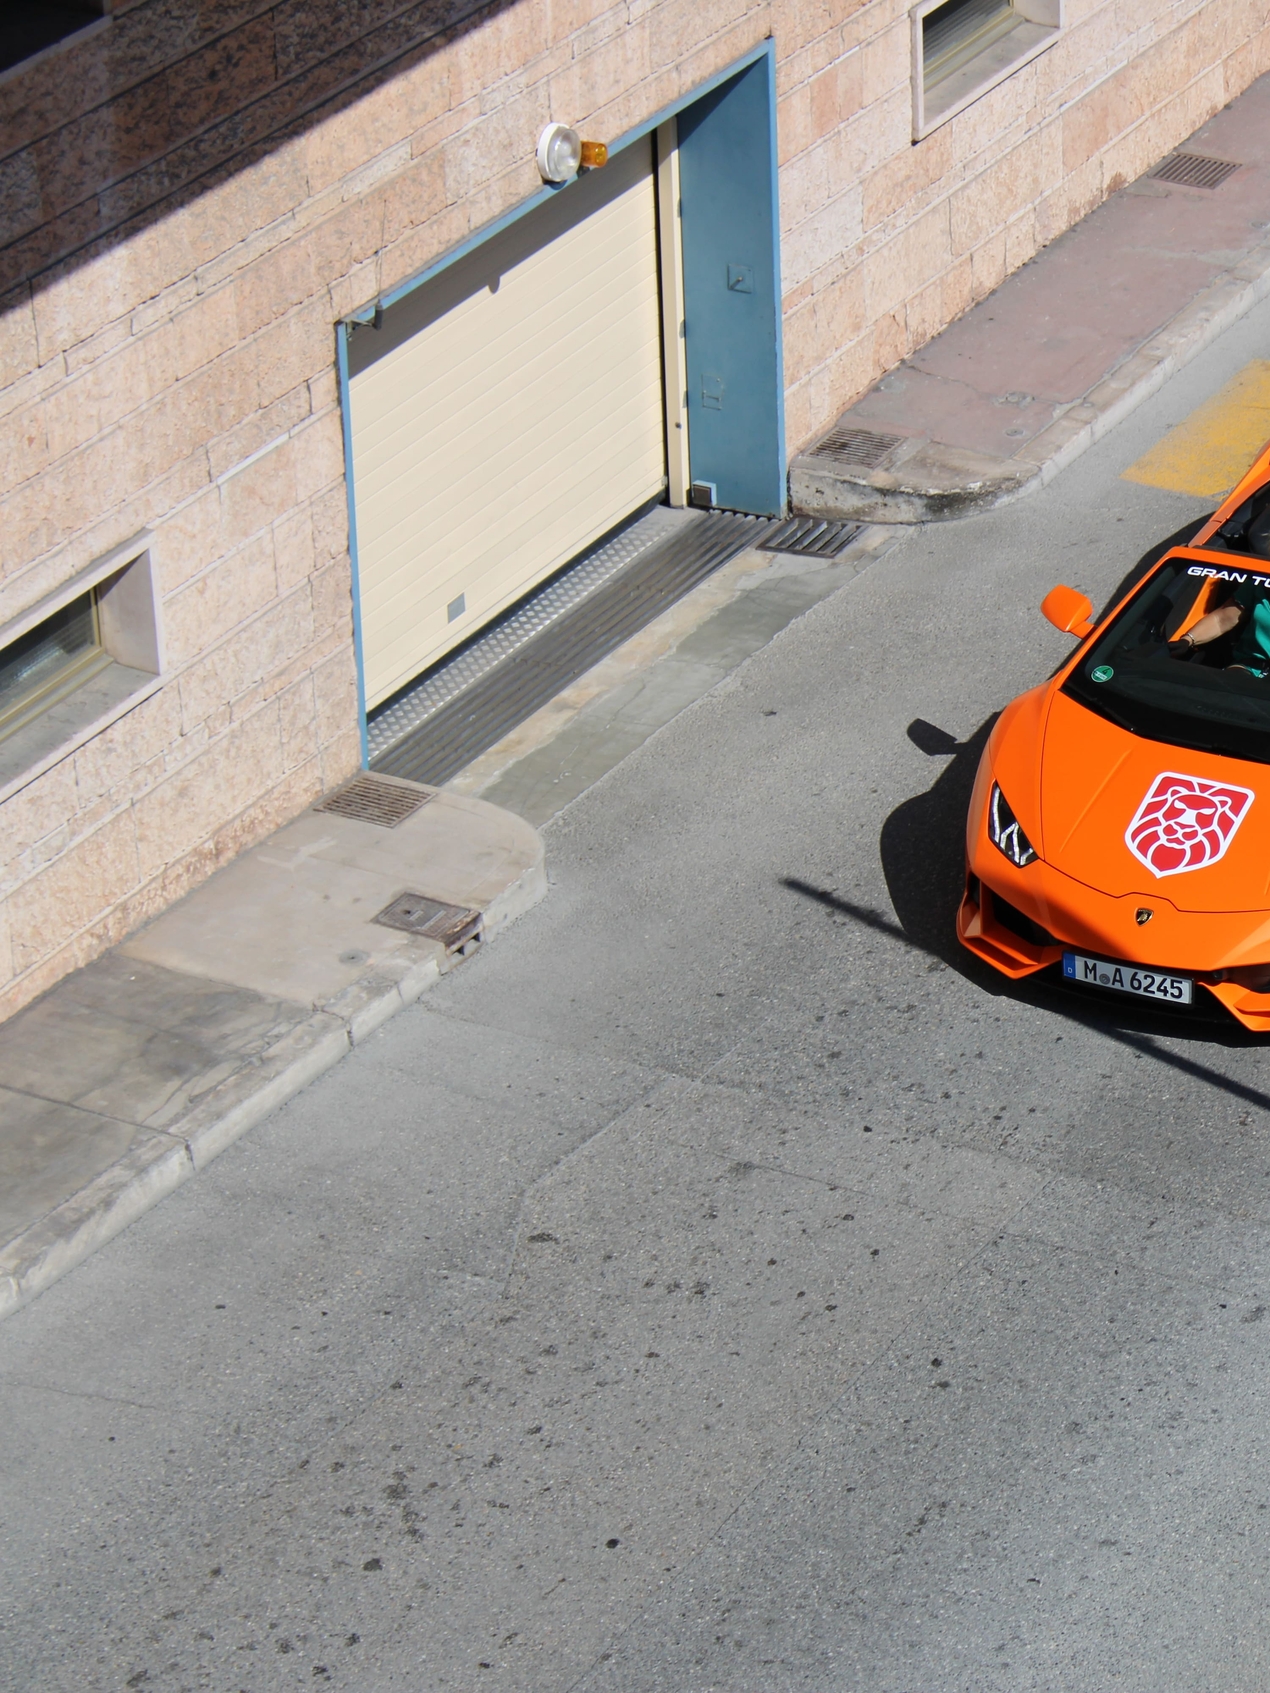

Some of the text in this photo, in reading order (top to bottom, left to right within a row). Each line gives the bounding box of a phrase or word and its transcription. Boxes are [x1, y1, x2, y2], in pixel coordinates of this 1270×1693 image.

[1187, 566, 1248, 583] GRAN
[1084, 960, 1183, 999] M A 6245
